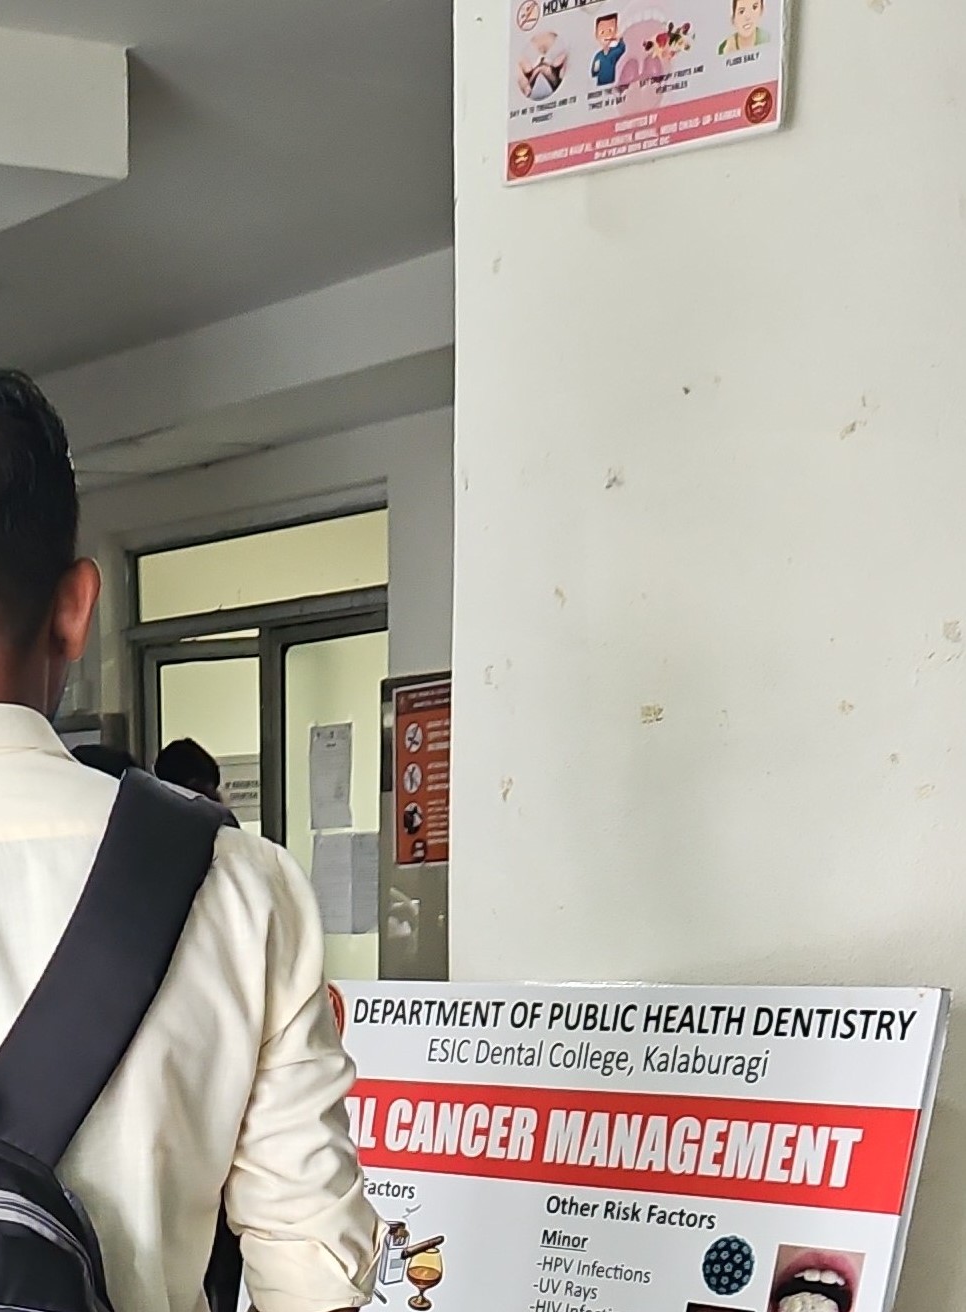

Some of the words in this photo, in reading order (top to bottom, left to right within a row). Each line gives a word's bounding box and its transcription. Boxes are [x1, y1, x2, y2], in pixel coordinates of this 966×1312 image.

[353, 998, 505, 1027] DEPARTMENT
[510, 1001, 543, 1028] OF
[547, 1002, 637, 1032] PUBLIC
[642, 1004, 746, 1035] HEALTH
[752, 1006, 916, 1040] DENTISTRY
[427, 1038, 470, 1063] ESIC
[475, 1039, 543, 1066] Dental
[549, 1042, 633, 1076] College,
[642, 1046, 768, 1082] Kalaburagi
[384, 1100, 537, 1160] CANCER
[542, 1109, 863, 1187] MANAGEMENT
[546, 1195, 599, 1217] Other
[603, 1200, 641, 1222] Risk
[646, 1205, 716, 1229] Factors
[541, 1230, 588, 1251] Minor
[576, 1260, 651, 1283] Infections
[563, 1281, 597, 1301] Rays
